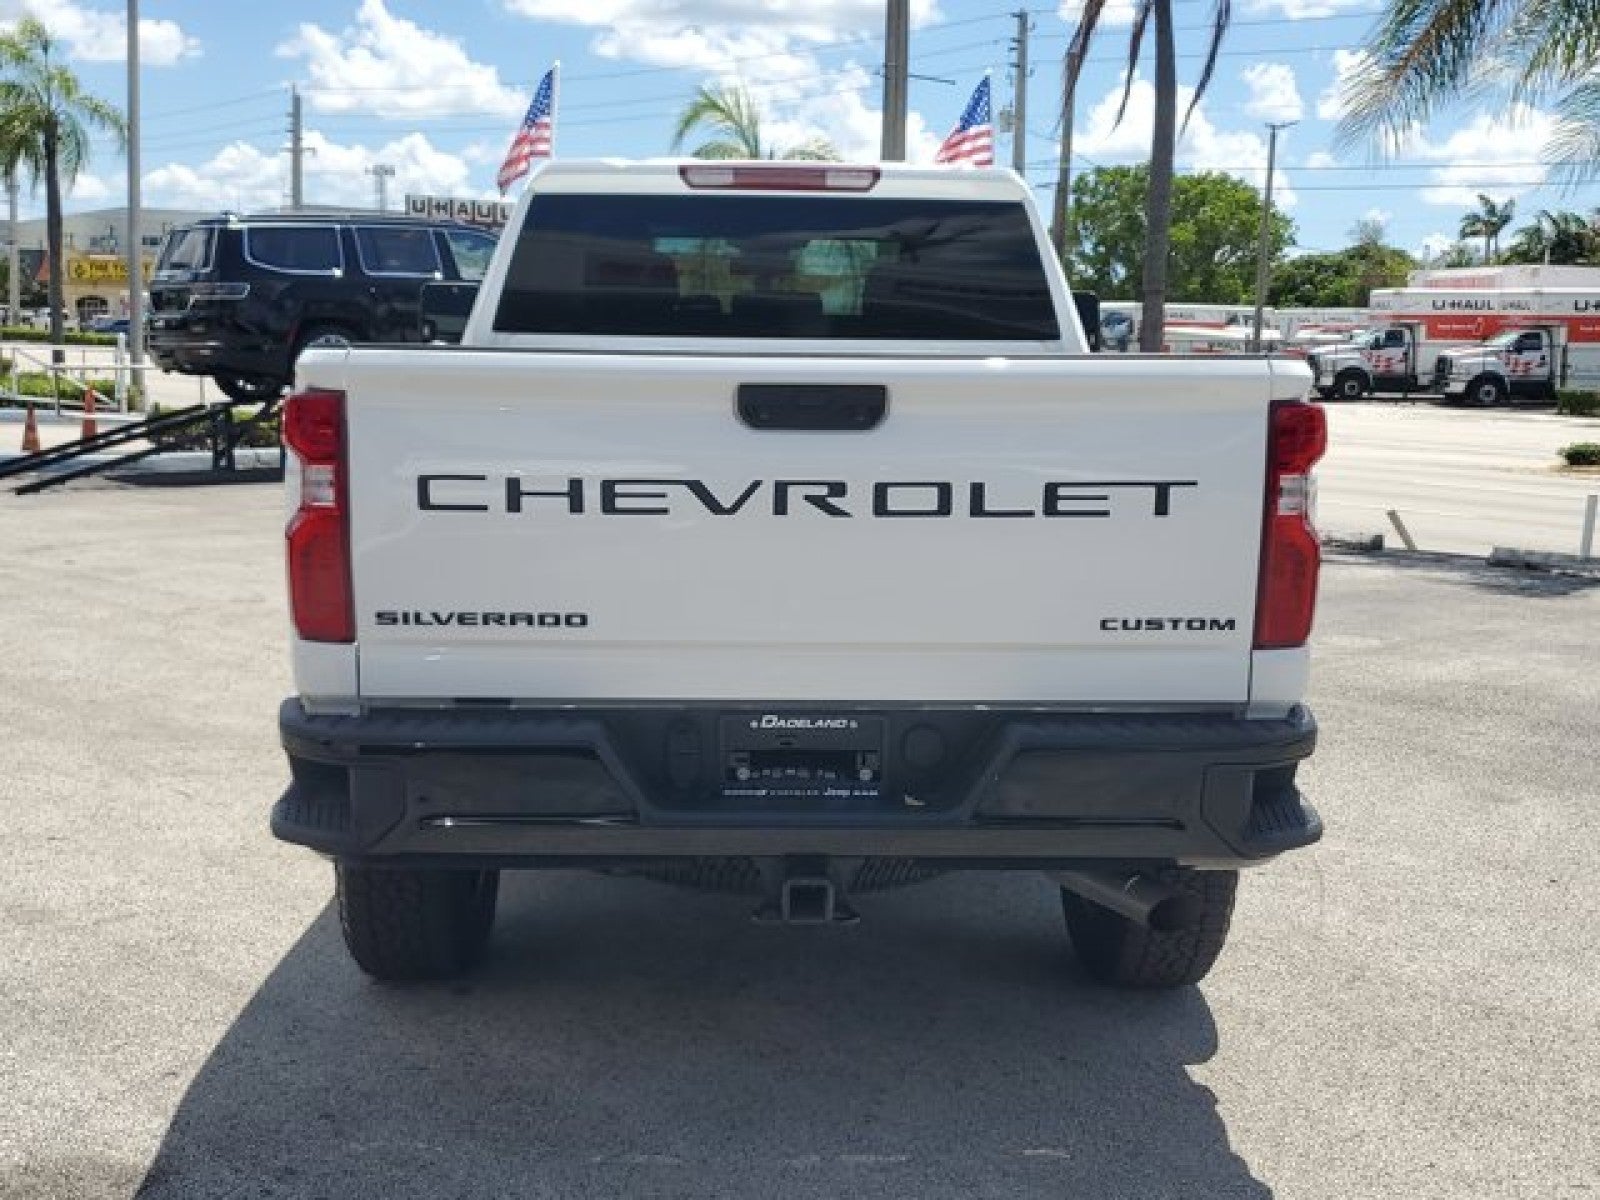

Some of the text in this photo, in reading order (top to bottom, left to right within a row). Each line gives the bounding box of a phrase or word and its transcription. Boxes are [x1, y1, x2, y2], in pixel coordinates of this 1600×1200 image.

[417, 474, 1198, 518] CHEVROLET
[375, 610, 588, 627] SILVERADO
[1099, 617, 1236, 631] CUSTOM
